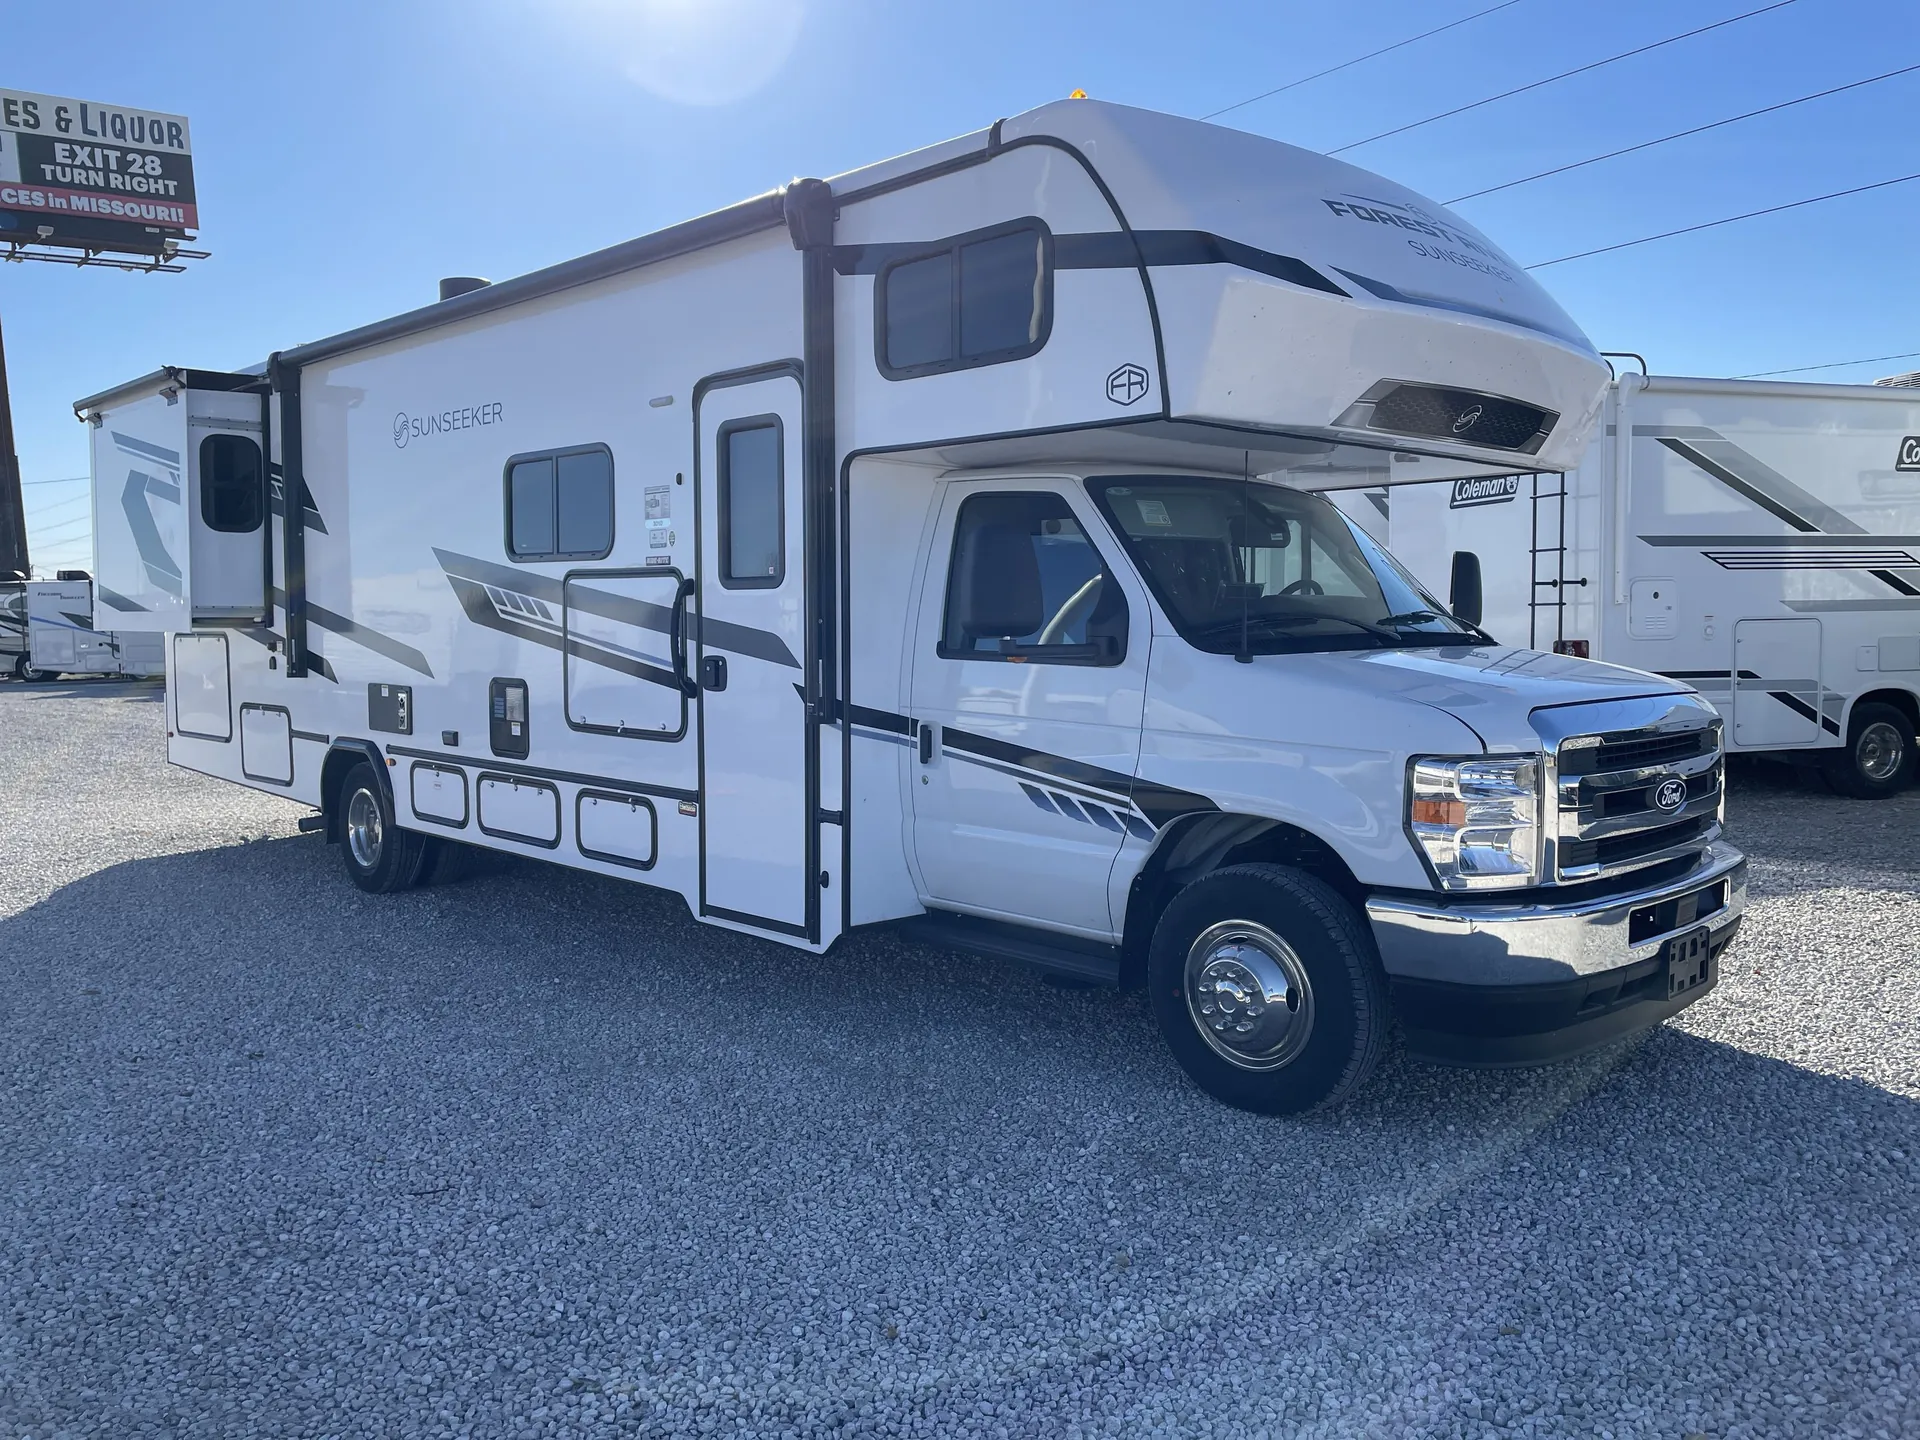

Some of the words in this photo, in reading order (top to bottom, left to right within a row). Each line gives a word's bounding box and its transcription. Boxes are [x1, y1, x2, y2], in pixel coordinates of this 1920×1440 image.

[2, 97, 41, 130] ES
[54, 105, 73, 134] &
[79, 102, 185, 150] LIQUOR
[53, 142, 121, 171] EXIT
[126, 153, 163, 176] 28
[40, 164, 105, 188] TURN
[108, 172, 178, 196] RIGHT
[1, 188, 45, 208] CES
[48, 192, 68, 209] in
[70, 194, 185, 223] MISSOURI!
[1320, 198, 1454, 244] FOREST
[411, 402, 503, 438] SUNSEEKER
[1455, 478, 1505, 501] Coleman
[1661, 784, 1682, 805] Ford
